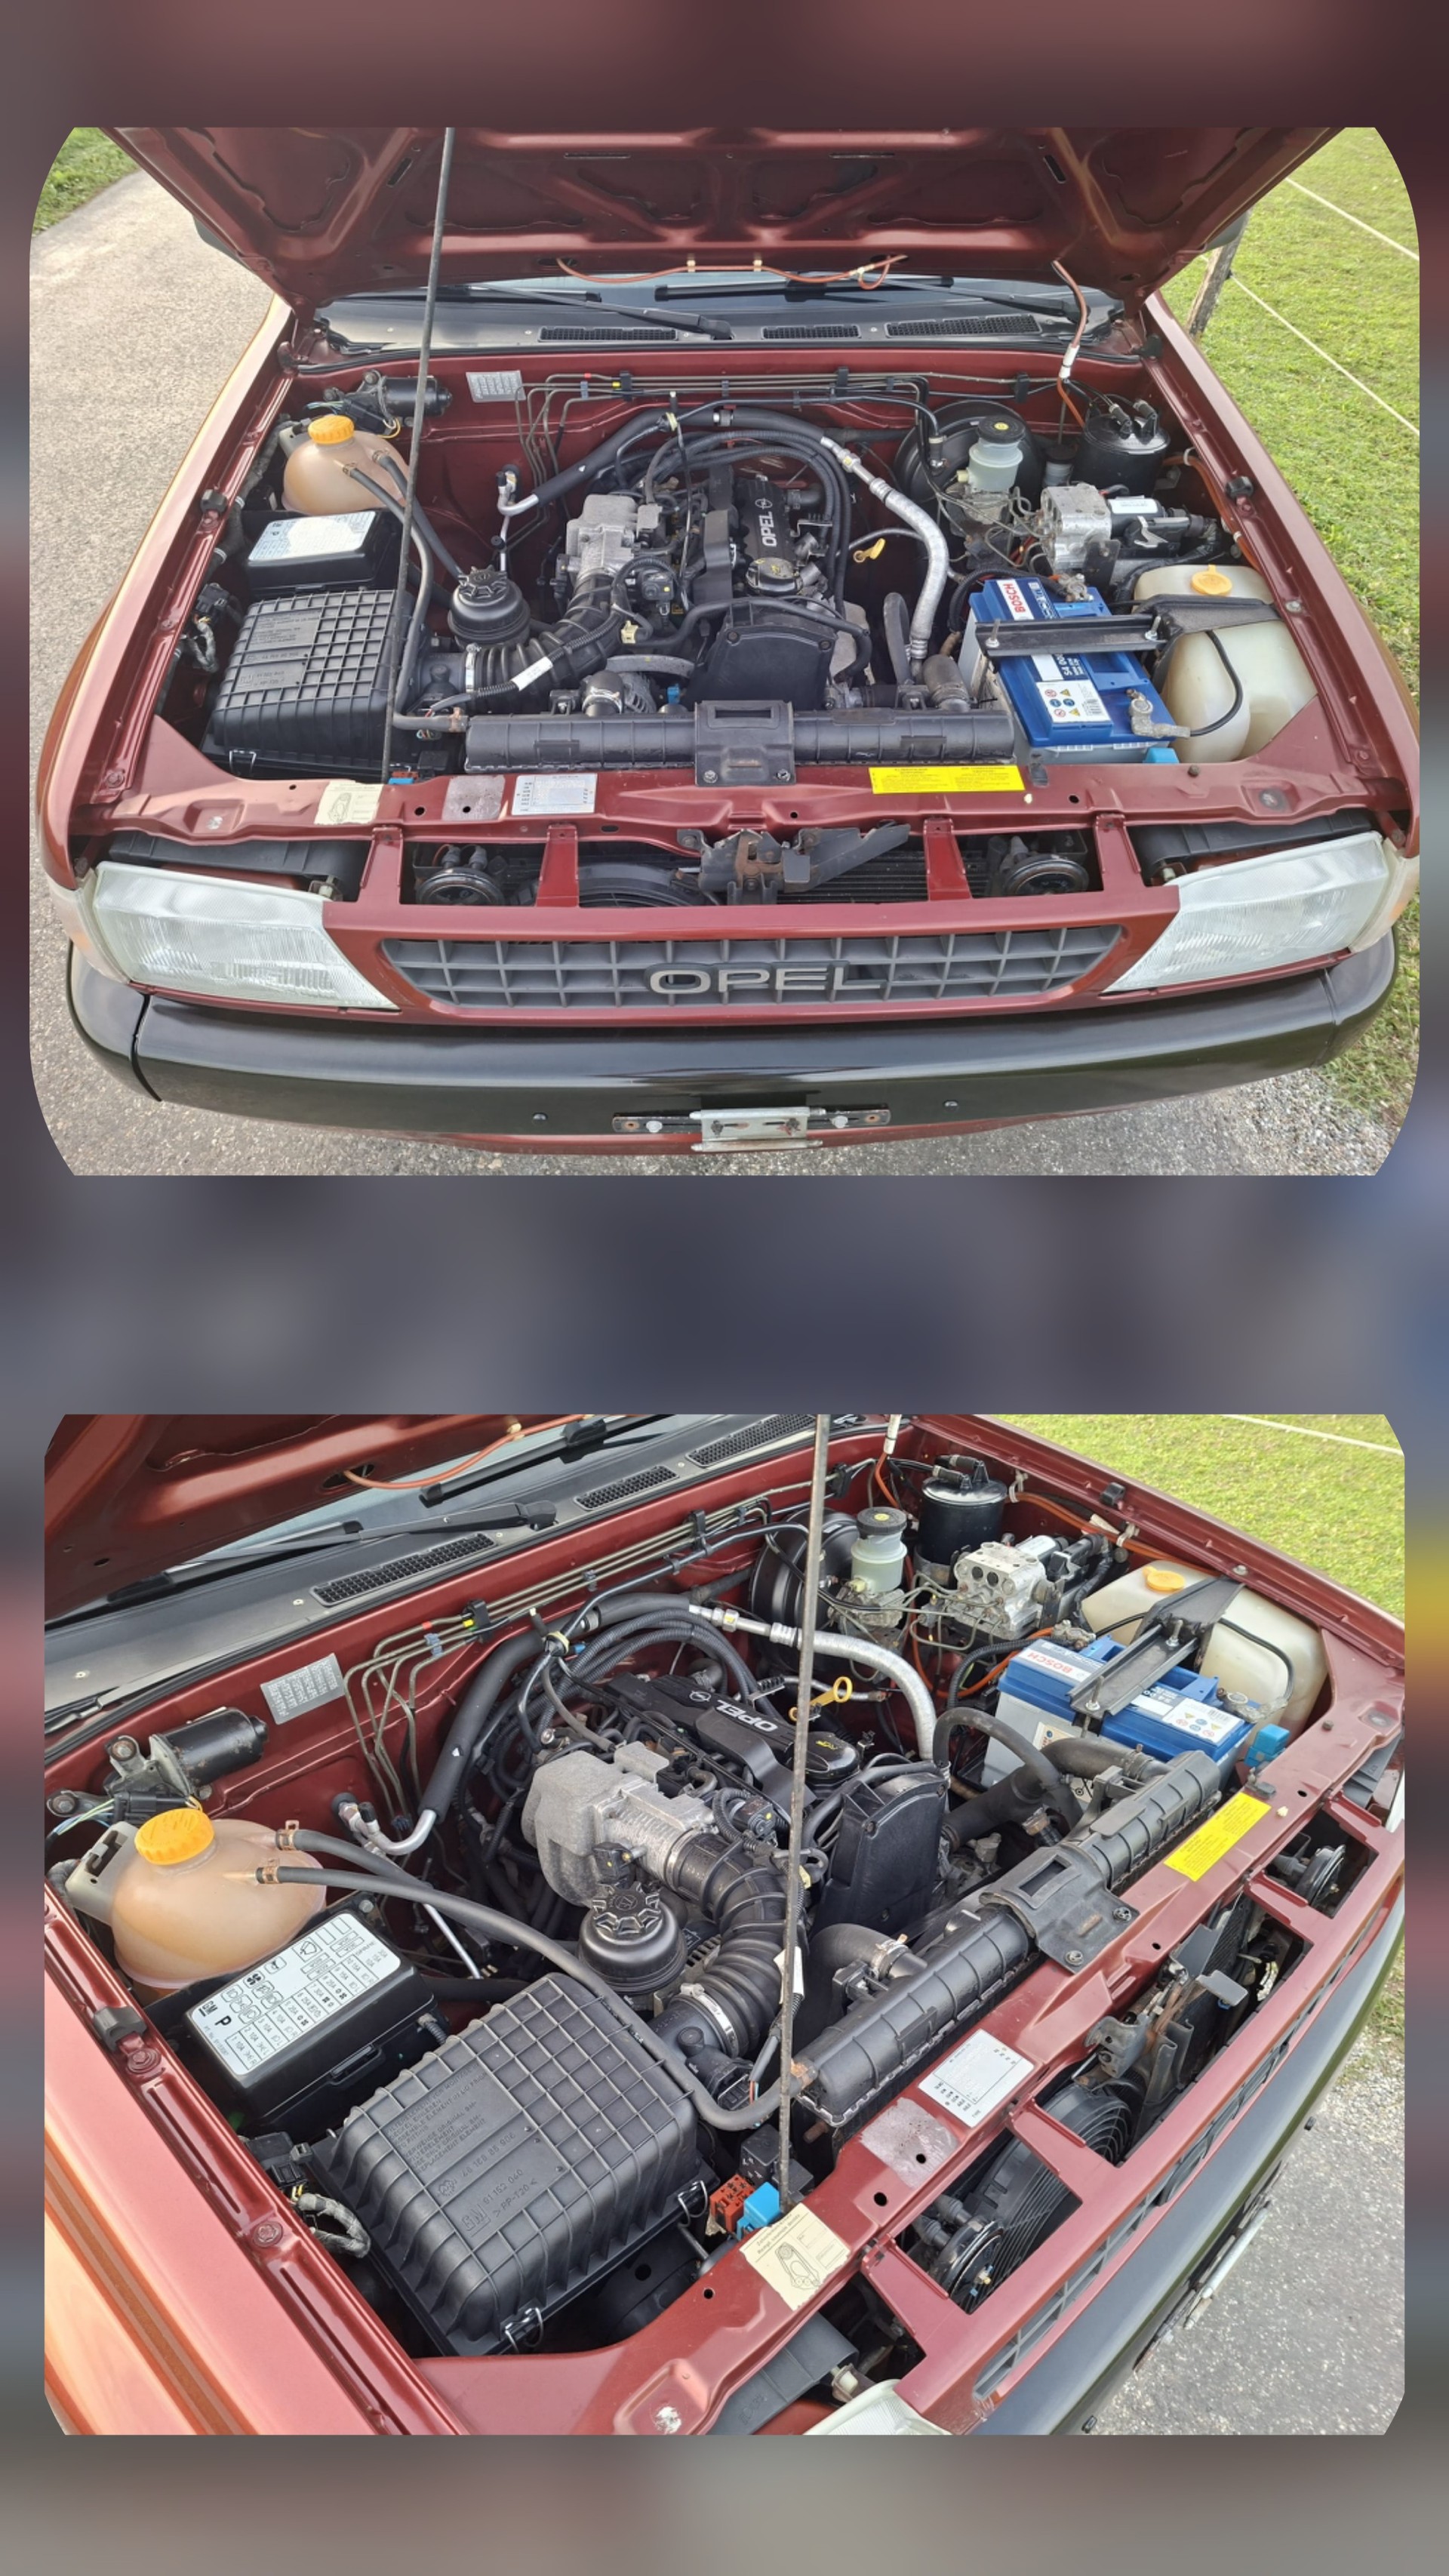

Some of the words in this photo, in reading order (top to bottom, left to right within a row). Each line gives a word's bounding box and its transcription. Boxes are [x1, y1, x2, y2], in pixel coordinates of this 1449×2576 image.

[758, 511, 777, 547] OPEL
[1003, 583, 1026, 613] BOSCH
[650, 966, 881, 994] OPEL
[1027, 1652, 1074, 1673] BOSCH
[716, 1700, 778, 1732] OPEL
[214, 2014, 232, 2028] P
